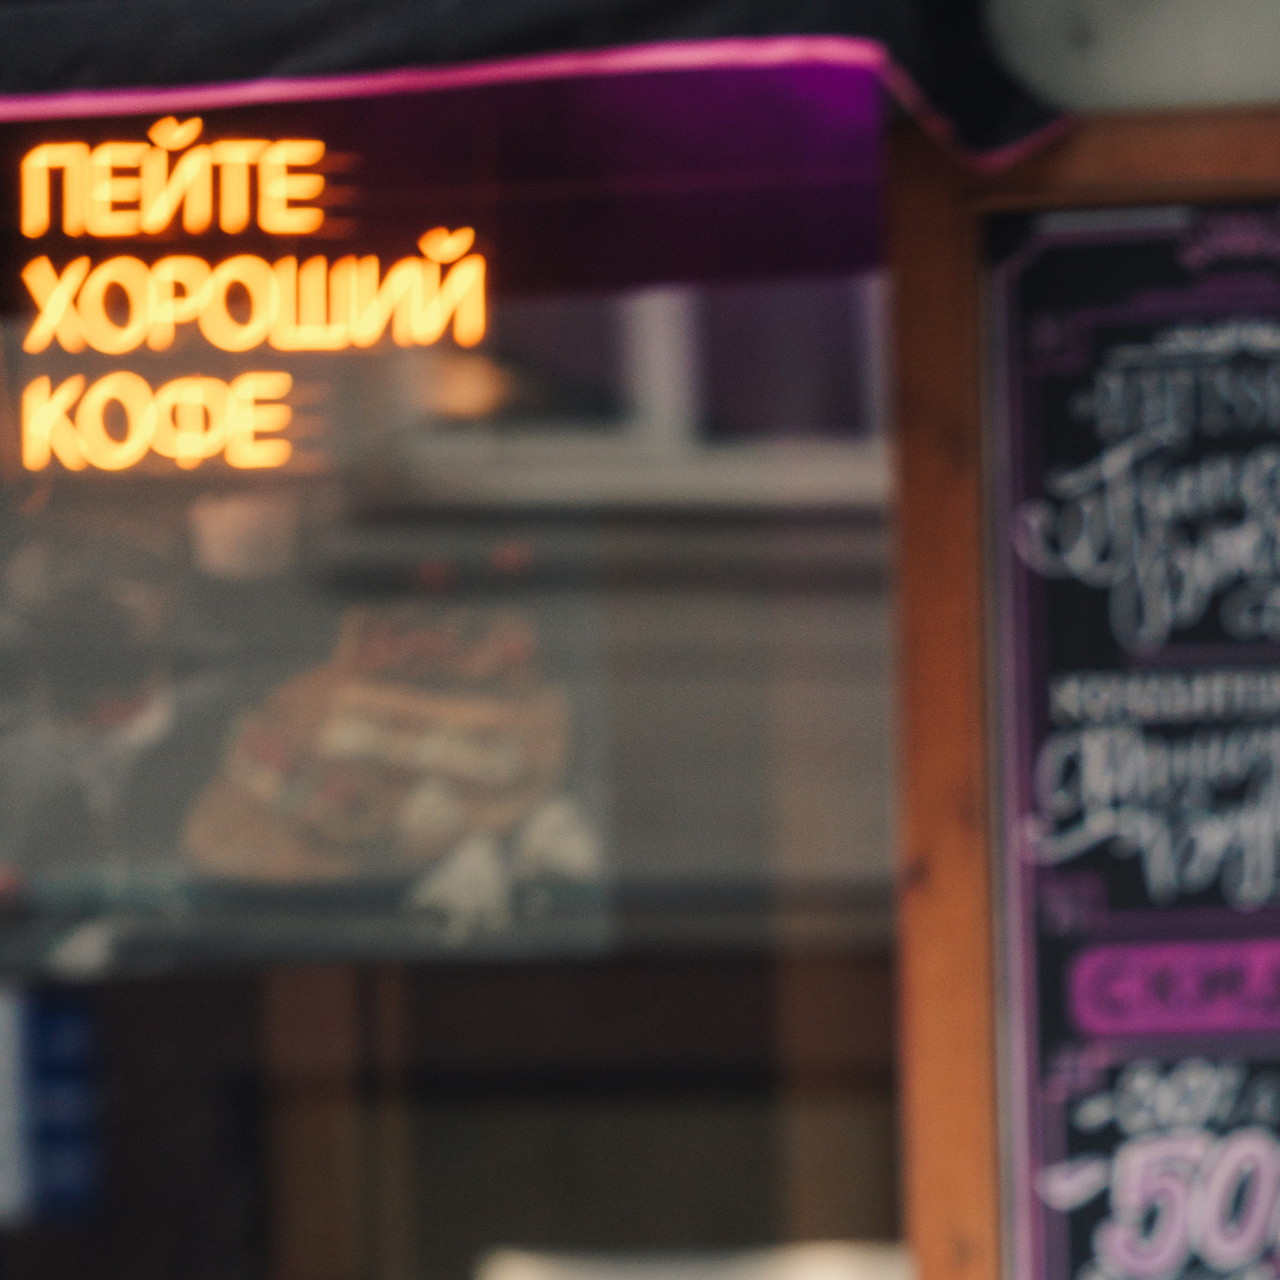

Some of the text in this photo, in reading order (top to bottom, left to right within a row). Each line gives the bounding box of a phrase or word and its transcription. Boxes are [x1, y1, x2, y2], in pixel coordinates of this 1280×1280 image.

[20, 116, 326, 238] ПЕЙТЕ
[21, 226, 488, 355] ХОРОШИЙ
[21, 371, 293, 471] КОФЕ
